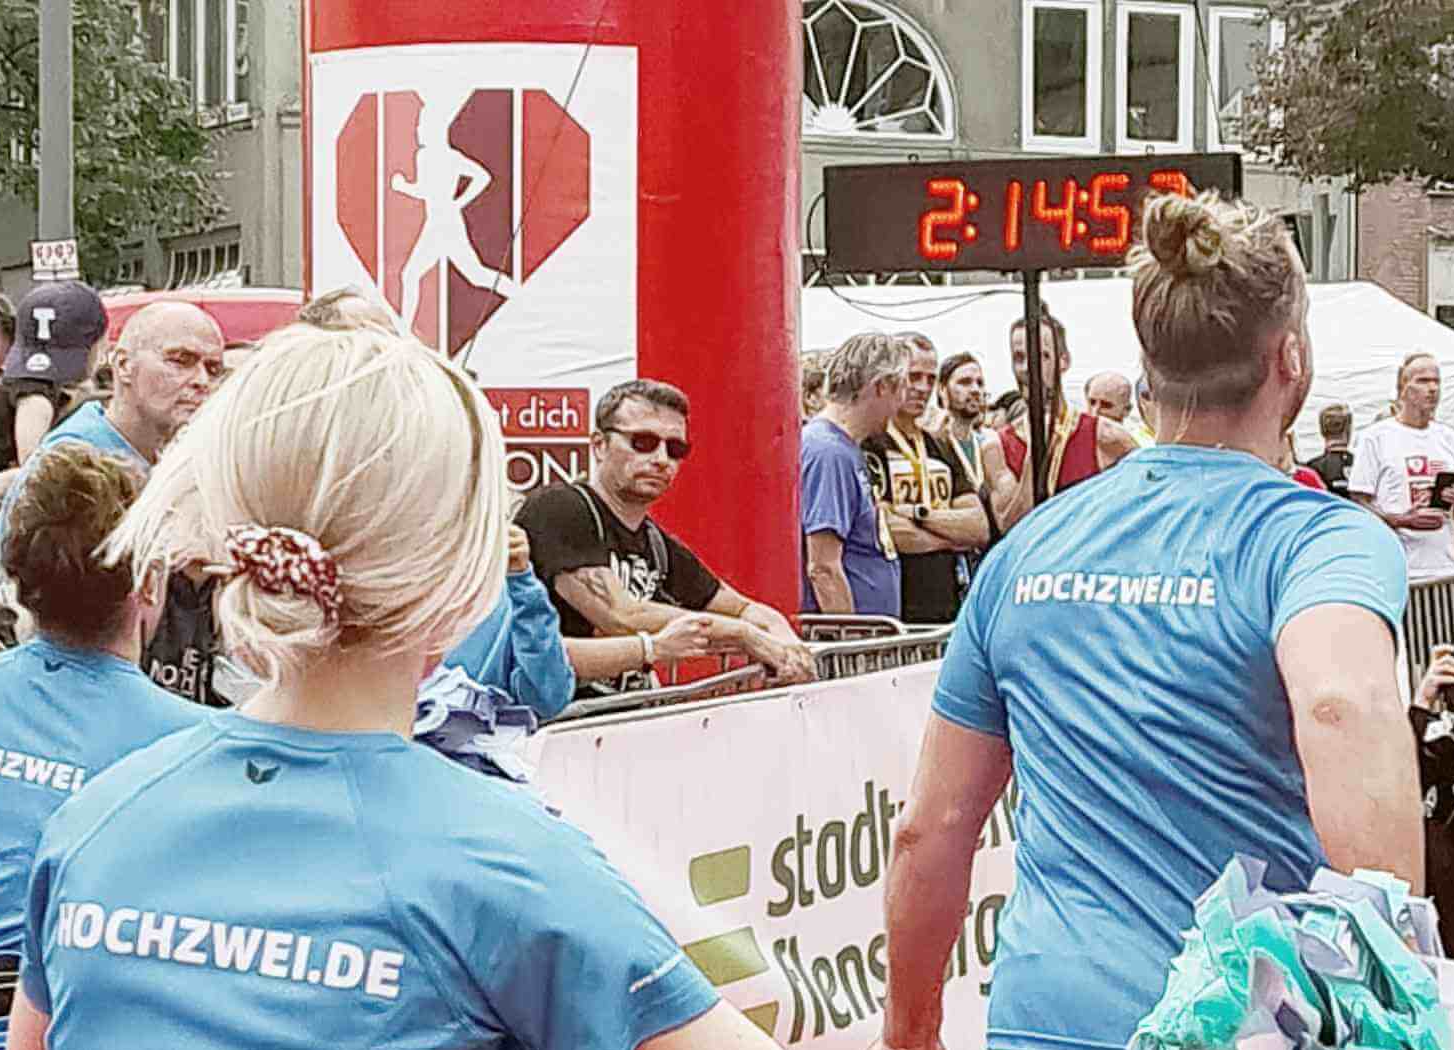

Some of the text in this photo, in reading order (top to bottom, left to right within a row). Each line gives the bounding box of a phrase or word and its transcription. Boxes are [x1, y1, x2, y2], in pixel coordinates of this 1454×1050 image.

[518, 395, 580, 429] dich
[1014, 571, 1217, 607] HOCHZWEI.DE
[55, 902, 405, 998] HOCHZWEI.DE
